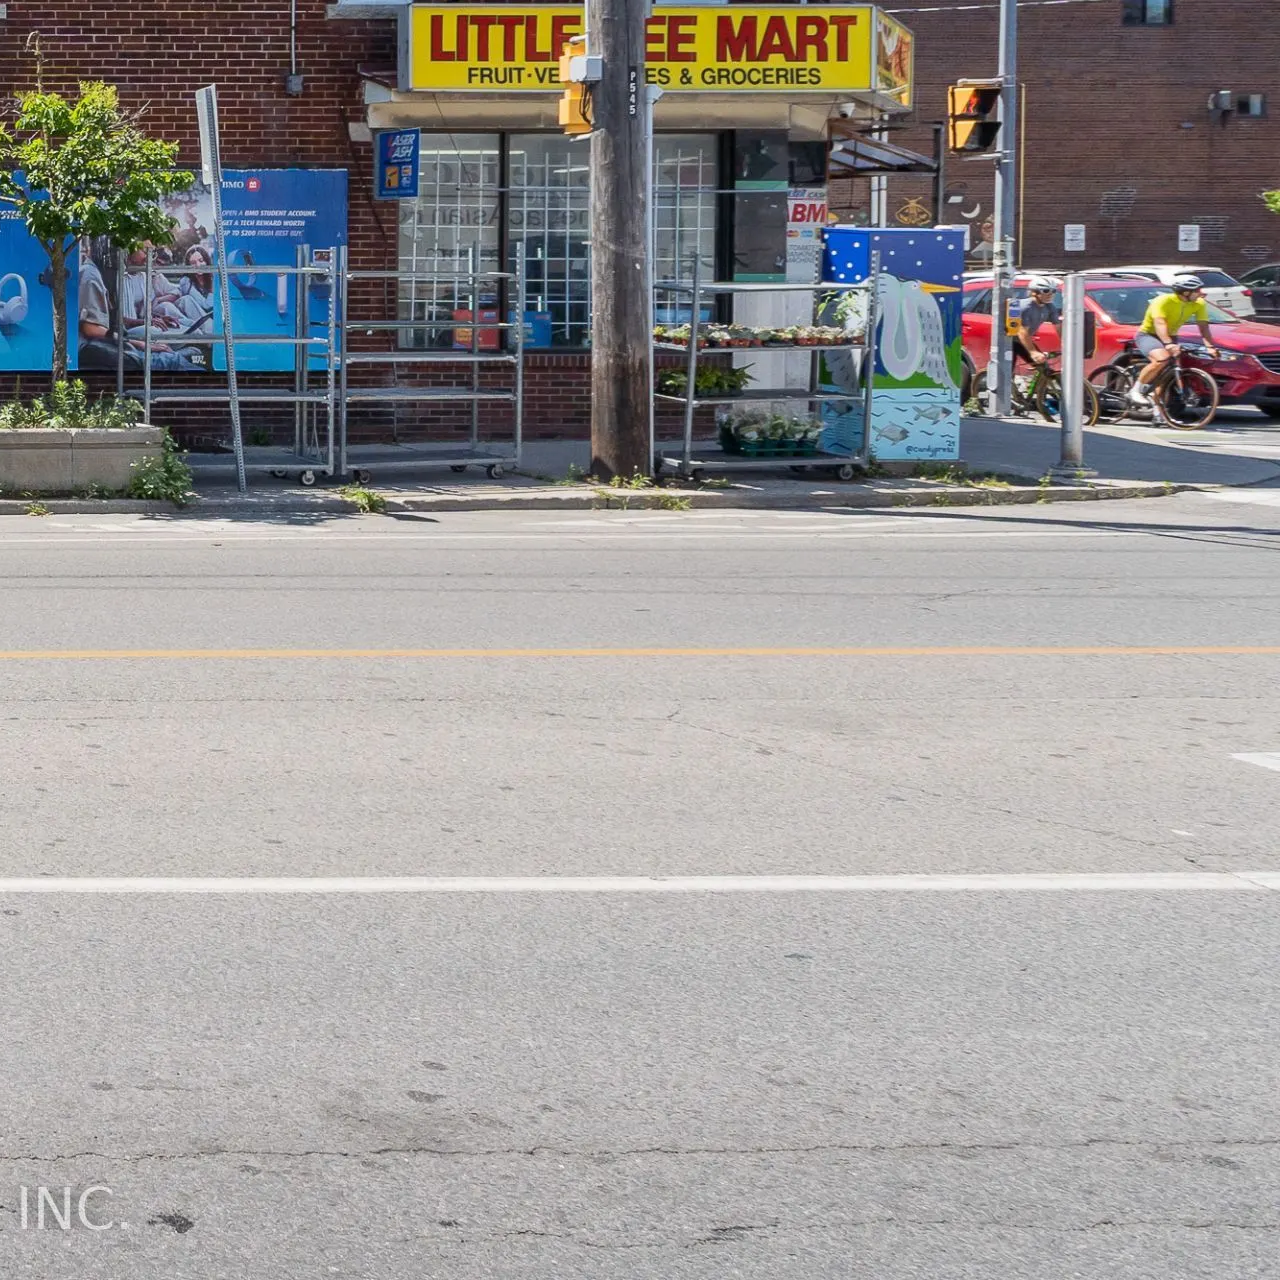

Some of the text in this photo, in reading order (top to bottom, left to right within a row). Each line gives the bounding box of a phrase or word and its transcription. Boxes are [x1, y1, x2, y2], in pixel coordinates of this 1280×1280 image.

[644, 15, 698, 62] EE
[716, 15, 857, 62] MART
[468, 67, 525, 84] FRUIT
[679, 68, 693, 85] &
[701, 68, 822, 85] GROCERIES
[628, 71, 637, 115] P545
[222, 181, 244, 189] BMO
[788, 203, 827, 223] BM
